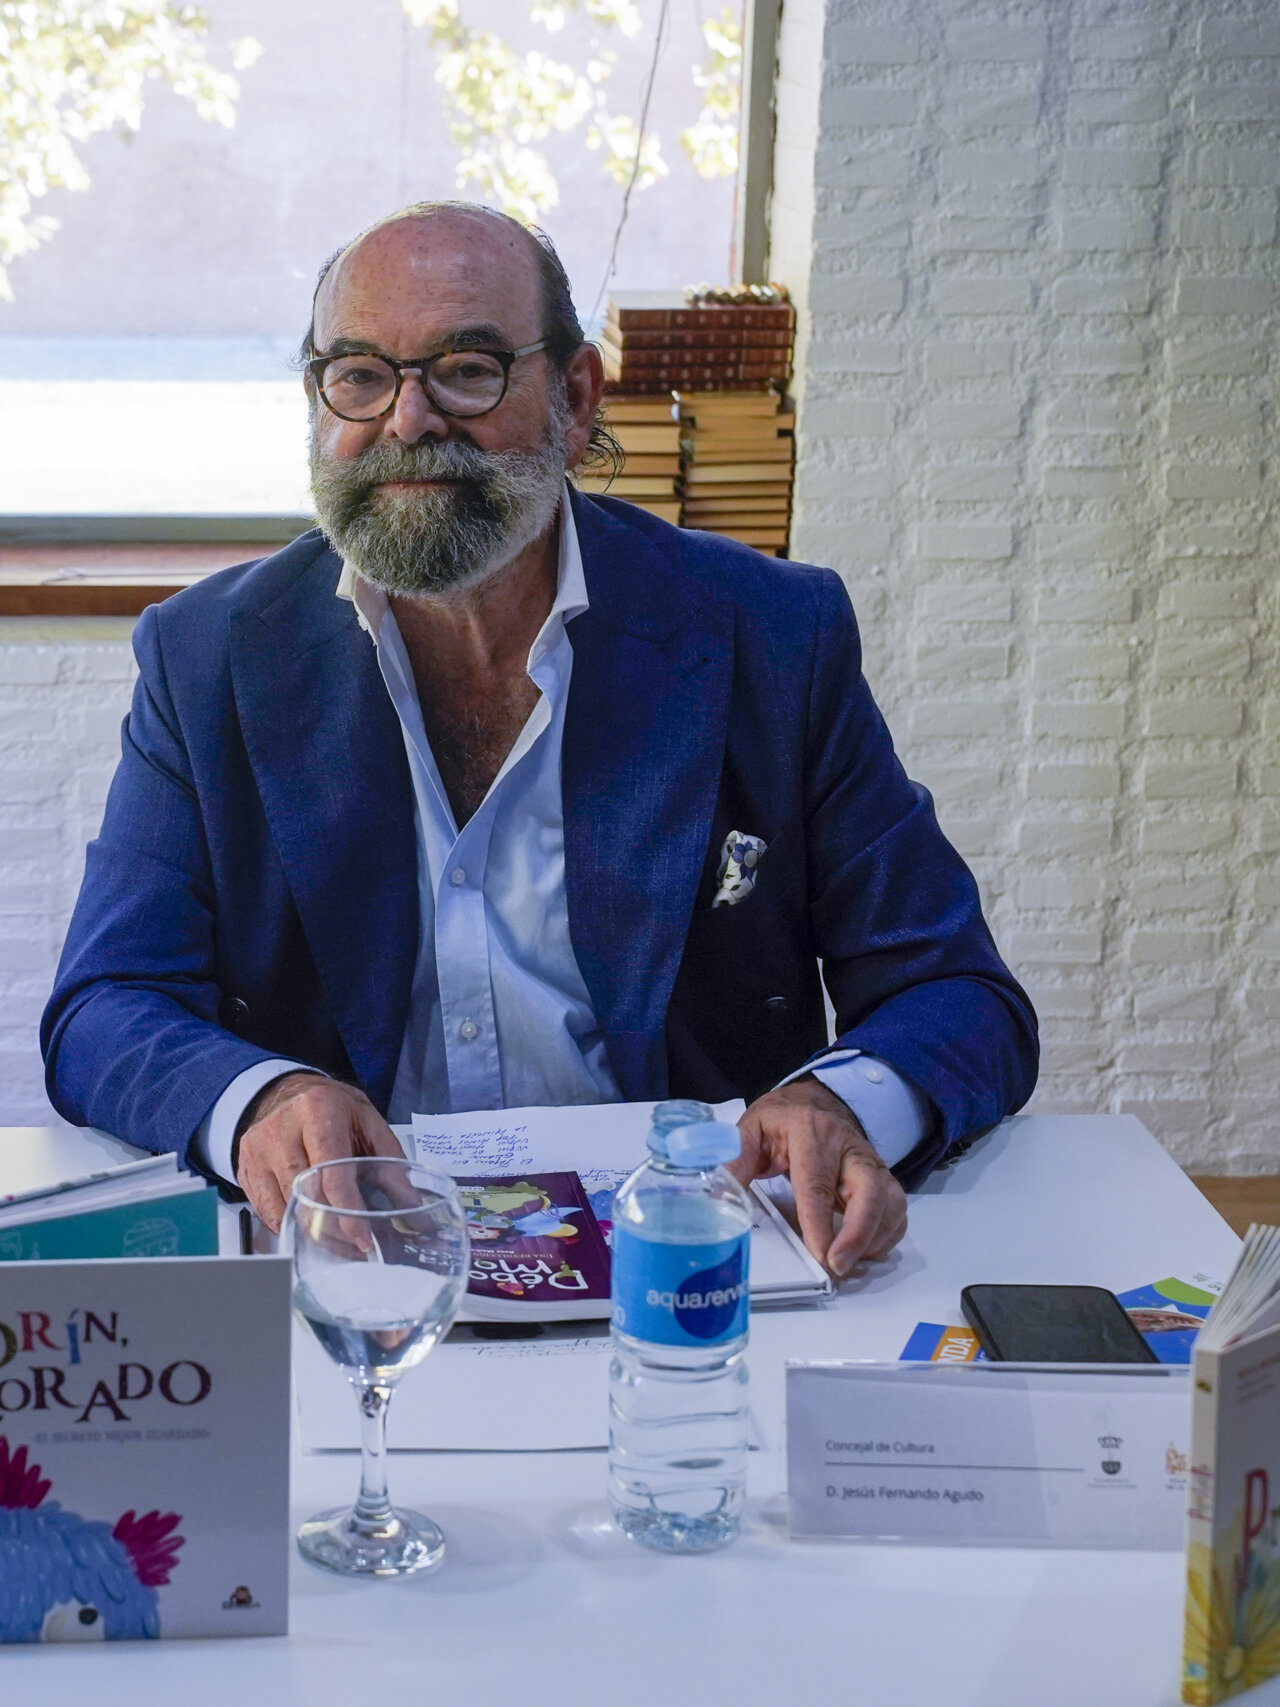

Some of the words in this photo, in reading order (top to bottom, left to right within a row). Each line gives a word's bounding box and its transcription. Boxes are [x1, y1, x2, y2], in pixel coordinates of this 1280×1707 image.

[825, 1440, 874, 1454] Concejal
[876, 1441, 890, 1452] de
[892, 1441, 936, 1454] Cultura
[825, 1484, 838, 1498] D.
[841, 1485, 875, 1500] Jesús
[877, 1485, 940, 1500] Fernando
[942, 1487, 985, 1504] Agudo
